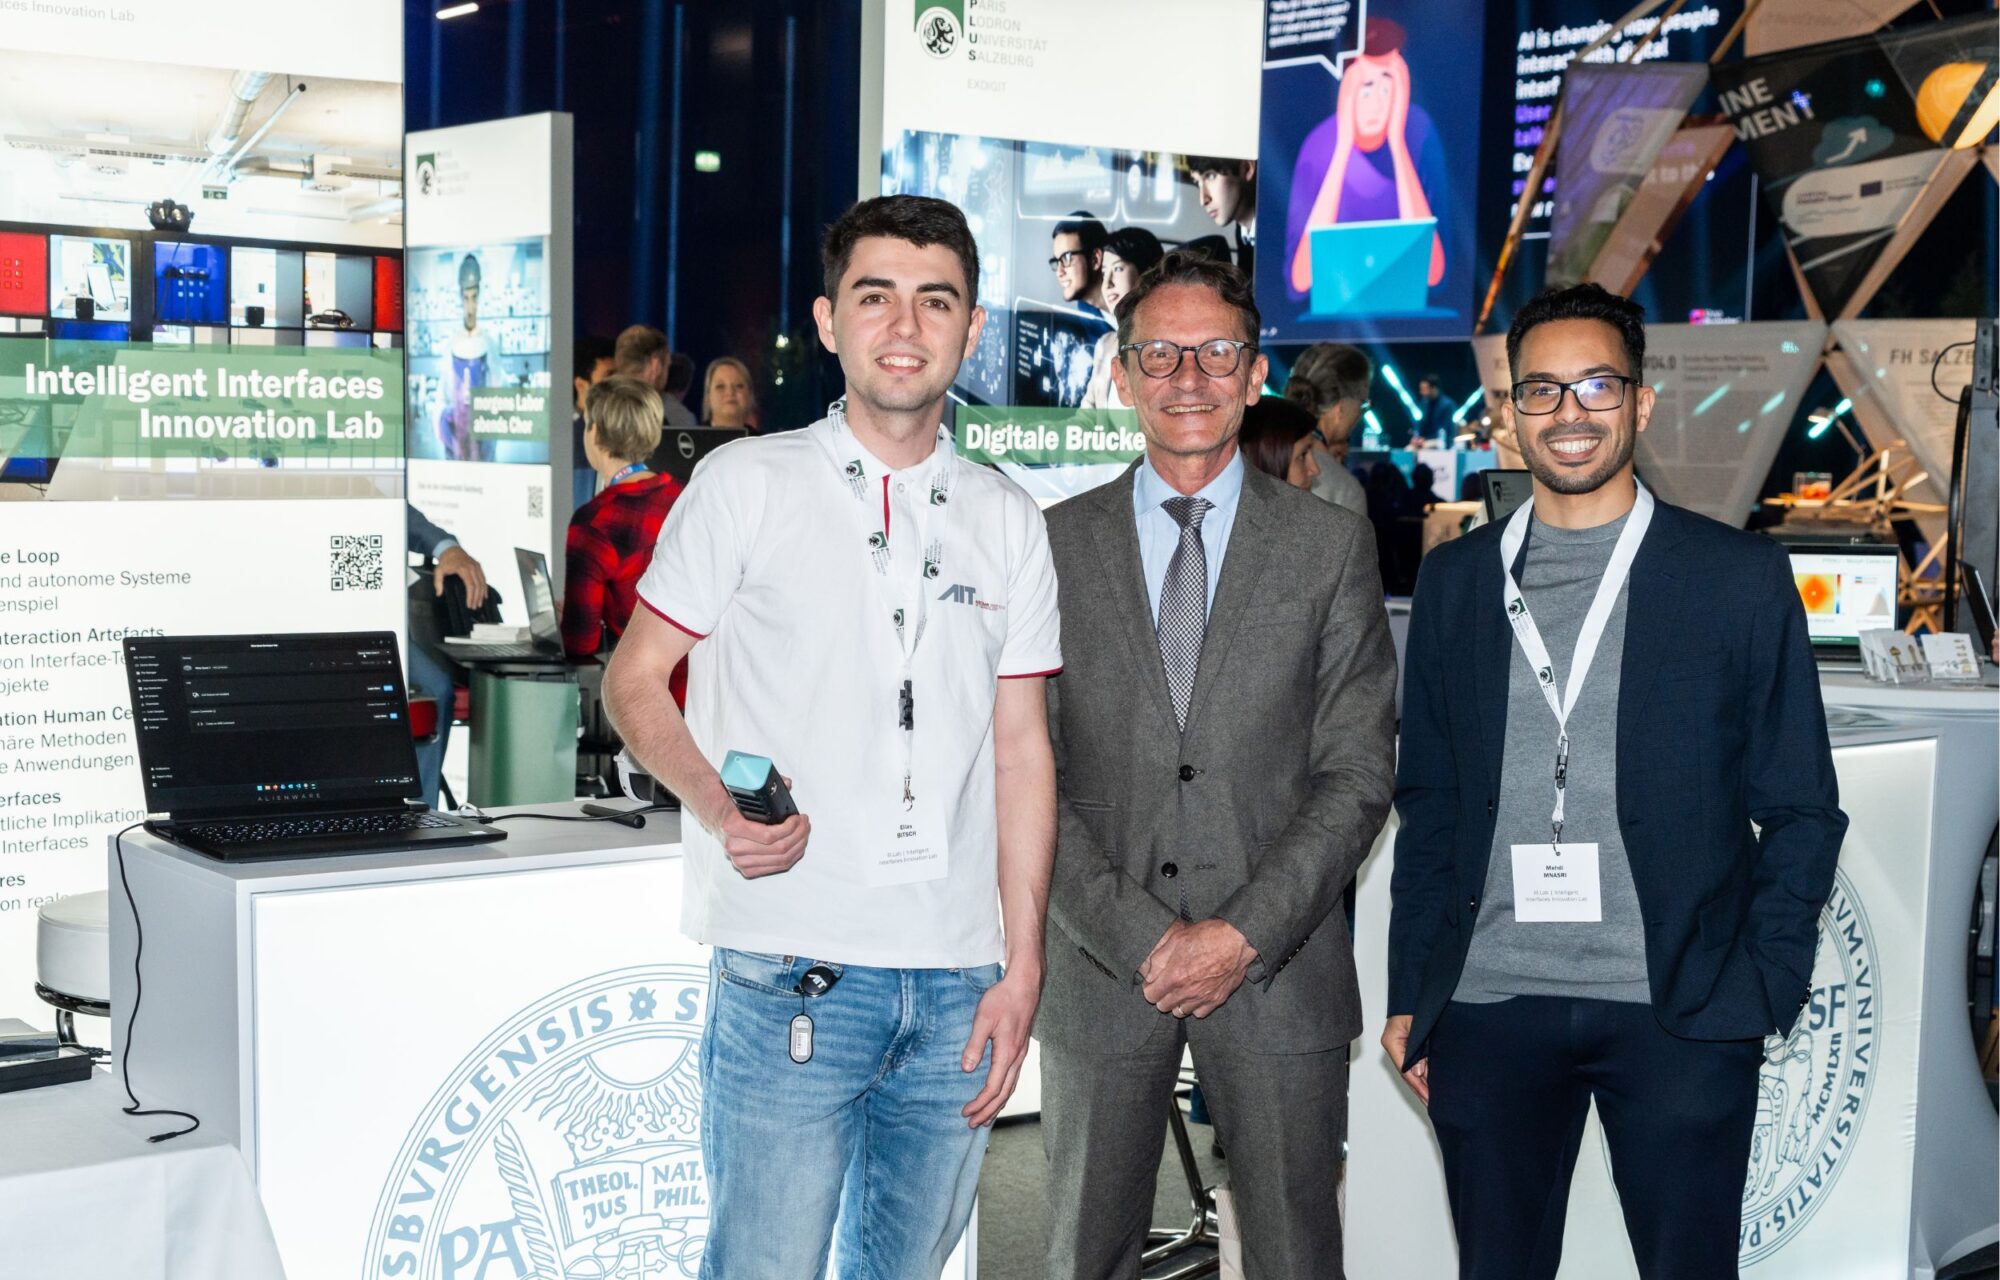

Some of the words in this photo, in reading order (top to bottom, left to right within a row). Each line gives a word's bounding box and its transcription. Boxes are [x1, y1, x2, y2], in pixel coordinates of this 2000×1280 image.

[0, 0, 27, 11] ces
[32, 0, 106, 19] Innovation
[110, 7, 135, 21] Lab
[970, 0, 1006, 13] PARIS
[970, 16, 1021, 31] LODRON
[1661, 5, 1720, 36] people
[969, 33, 1048, 51] UNIVERSITÄT
[968, 50, 1034, 67] SALZBURG
[1889, 348, 1913, 365] FH
[25, 363, 208, 402] Intelligent
[217, 368, 384, 400] Interfaces
[140, 408, 316, 439] Innovation
[326, 410, 384, 439] Lab
[965, 423, 1060, 455] Digitale
[1066, 425, 1146, 452] Brücke
[18, 549, 60, 566] Loop
[28, 573, 115, 588] autonome
[120, 570, 191, 588] Systeme
[937, 584, 976, 605] AIT
[44, 709, 106, 724] Human
[41, 731, 127, 748] Methoden
[14, 754, 134, 773] Anwendungen
[257, 793, 321, 802] ALIENWARE
[3, 836, 89, 854] Interfaces
[28, 892, 69, 909] real
[652, 1160, 702, 1185] NAT.
[564, 1171, 639, 1201] THEOL.
[654, 1185, 706, 1209] PHIL.
[583, 1195, 627, 1229] JUS
